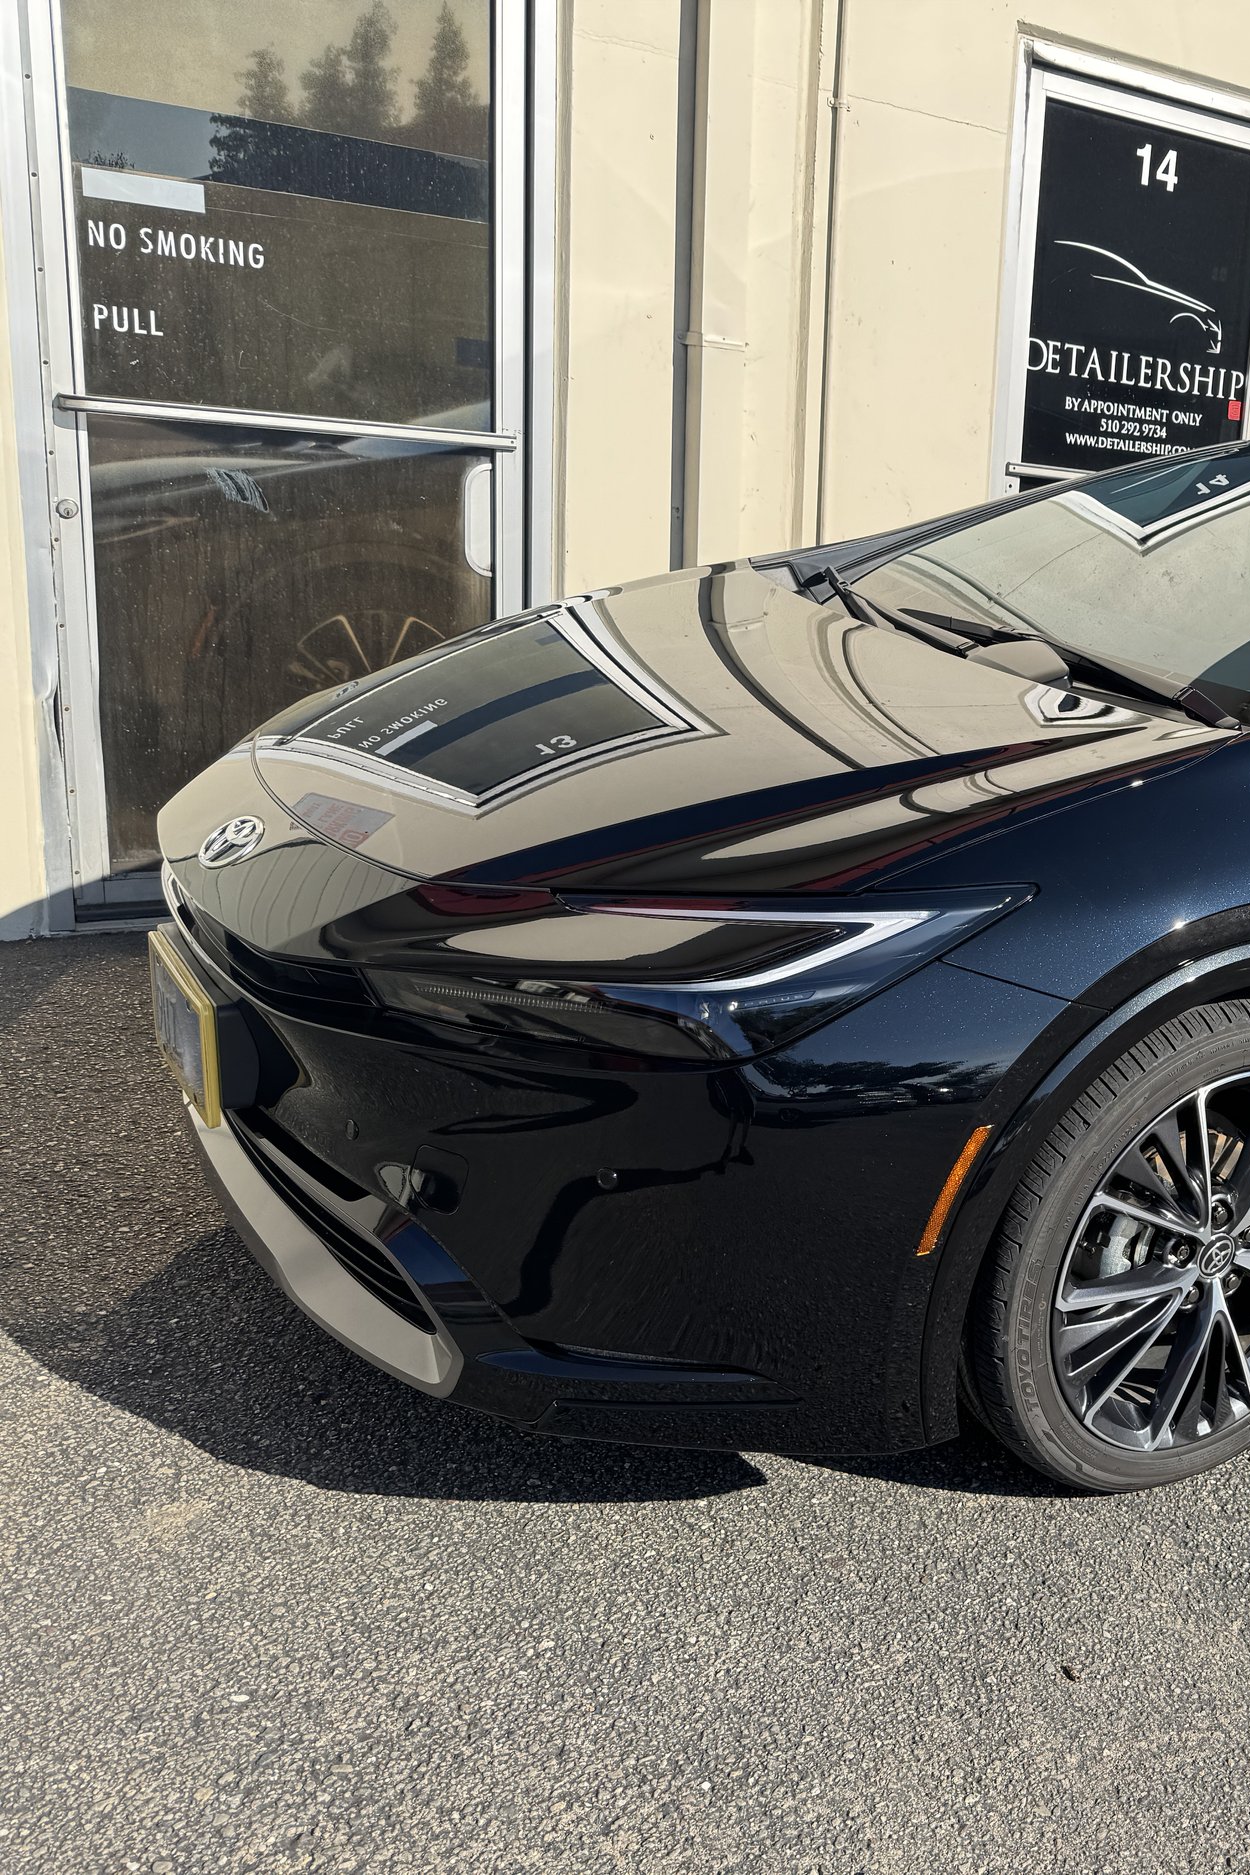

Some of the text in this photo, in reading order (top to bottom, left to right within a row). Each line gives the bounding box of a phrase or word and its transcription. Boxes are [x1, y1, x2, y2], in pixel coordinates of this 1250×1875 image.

[1136, 143, 1179, 192] 14
[88, 220, 266, 269] NO SMOKING
[93, 304, 164, 337] PULL
[1027, 337, 1244, 400] DETAILERSHIP
[1065, 396, 1203, 427] BY APPOINTMENT ONLY
[1100, 419, 1167, 439] 510 292 9734
[1065, 433, 1192, 456] WWW.DETAILERSHIP.CO
[1016, 1258, 1041, 1413] TOYO TIRES
